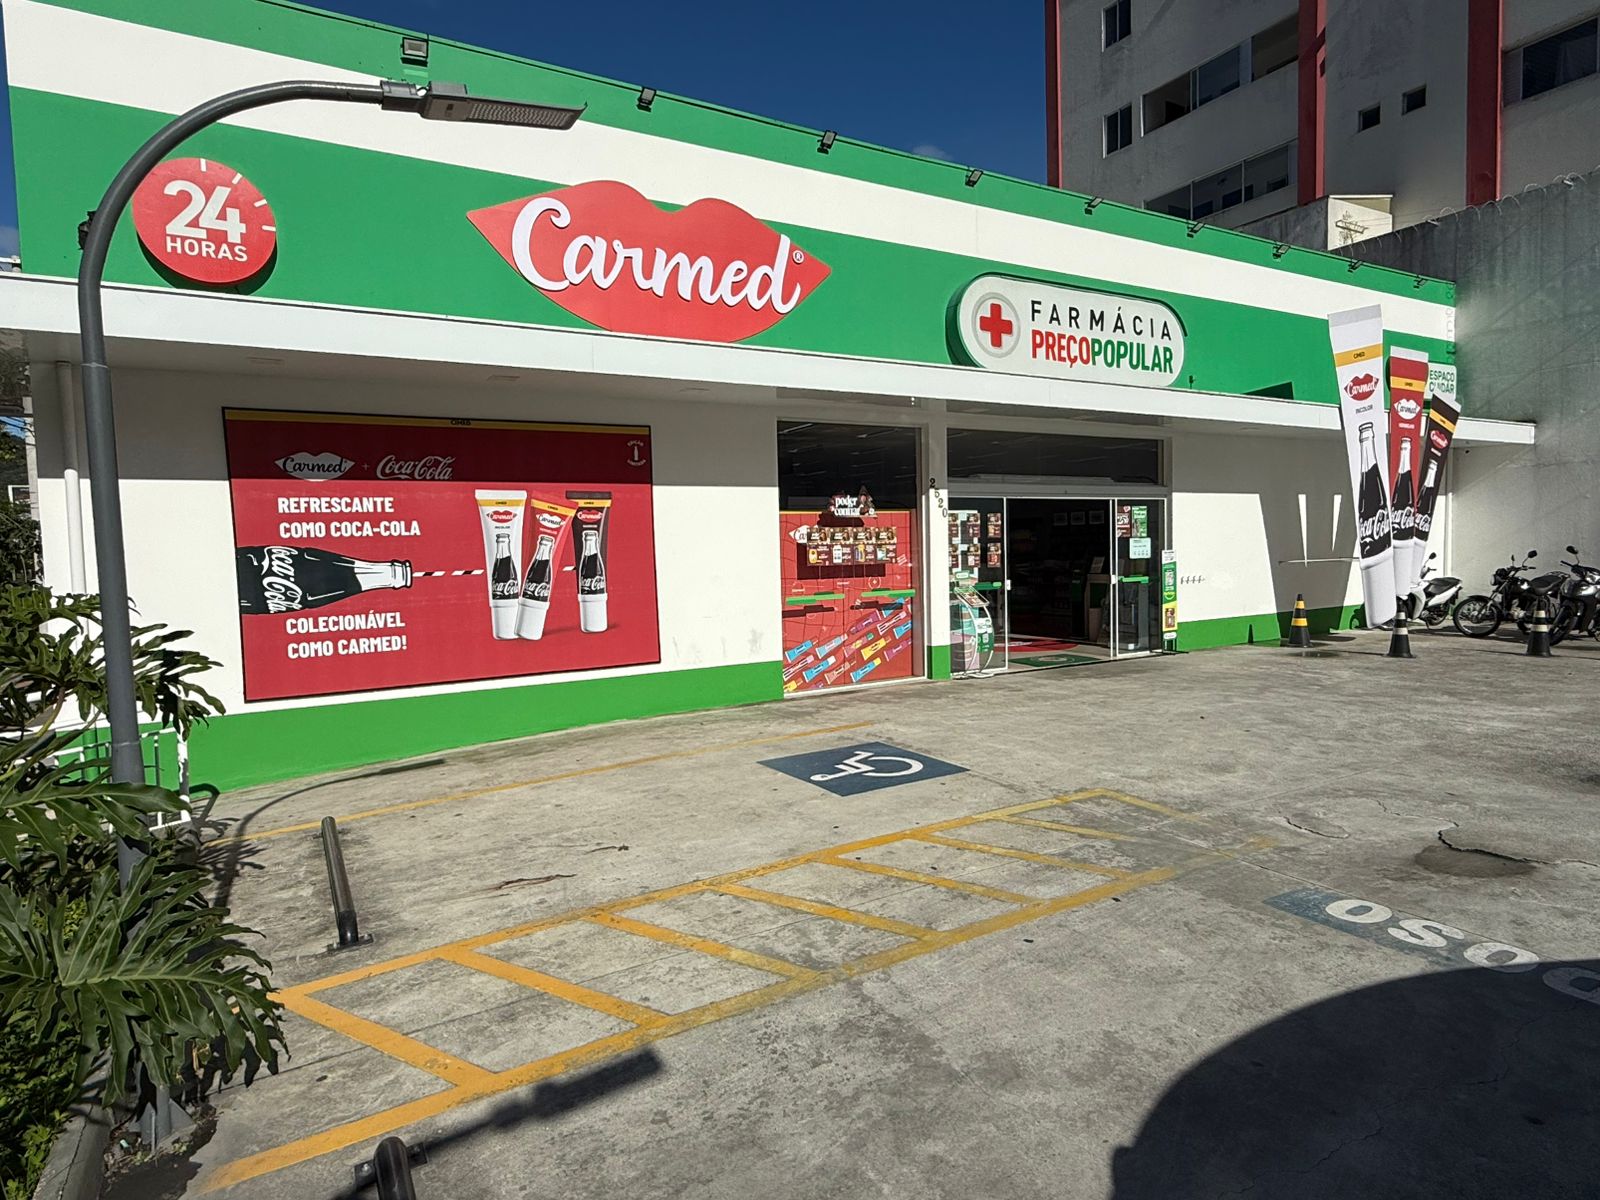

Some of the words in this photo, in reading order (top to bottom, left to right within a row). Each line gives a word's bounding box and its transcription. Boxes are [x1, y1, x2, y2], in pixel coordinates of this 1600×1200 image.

[163, 179, 247, 244] 24
[165, 236, 249, 262] HORAS
[511, 197, 800, 314] Carmed
[1031, 299, 1172, 341] FARMÁCIA
[282, 456, 346, 474] Carmed
[376, 454, 457, 480] Coca-Cola
[277, 496, 395, 514] REFRESCANTE
[278, 521, 326, 539] COMO
[330, 520, 421, 537] COCA-COLA
[285, 610, 406, 634] COLECIONÁVEL
[287, 640, 334, 659] COMO
[337, 635, 408, 655] CARMED!
